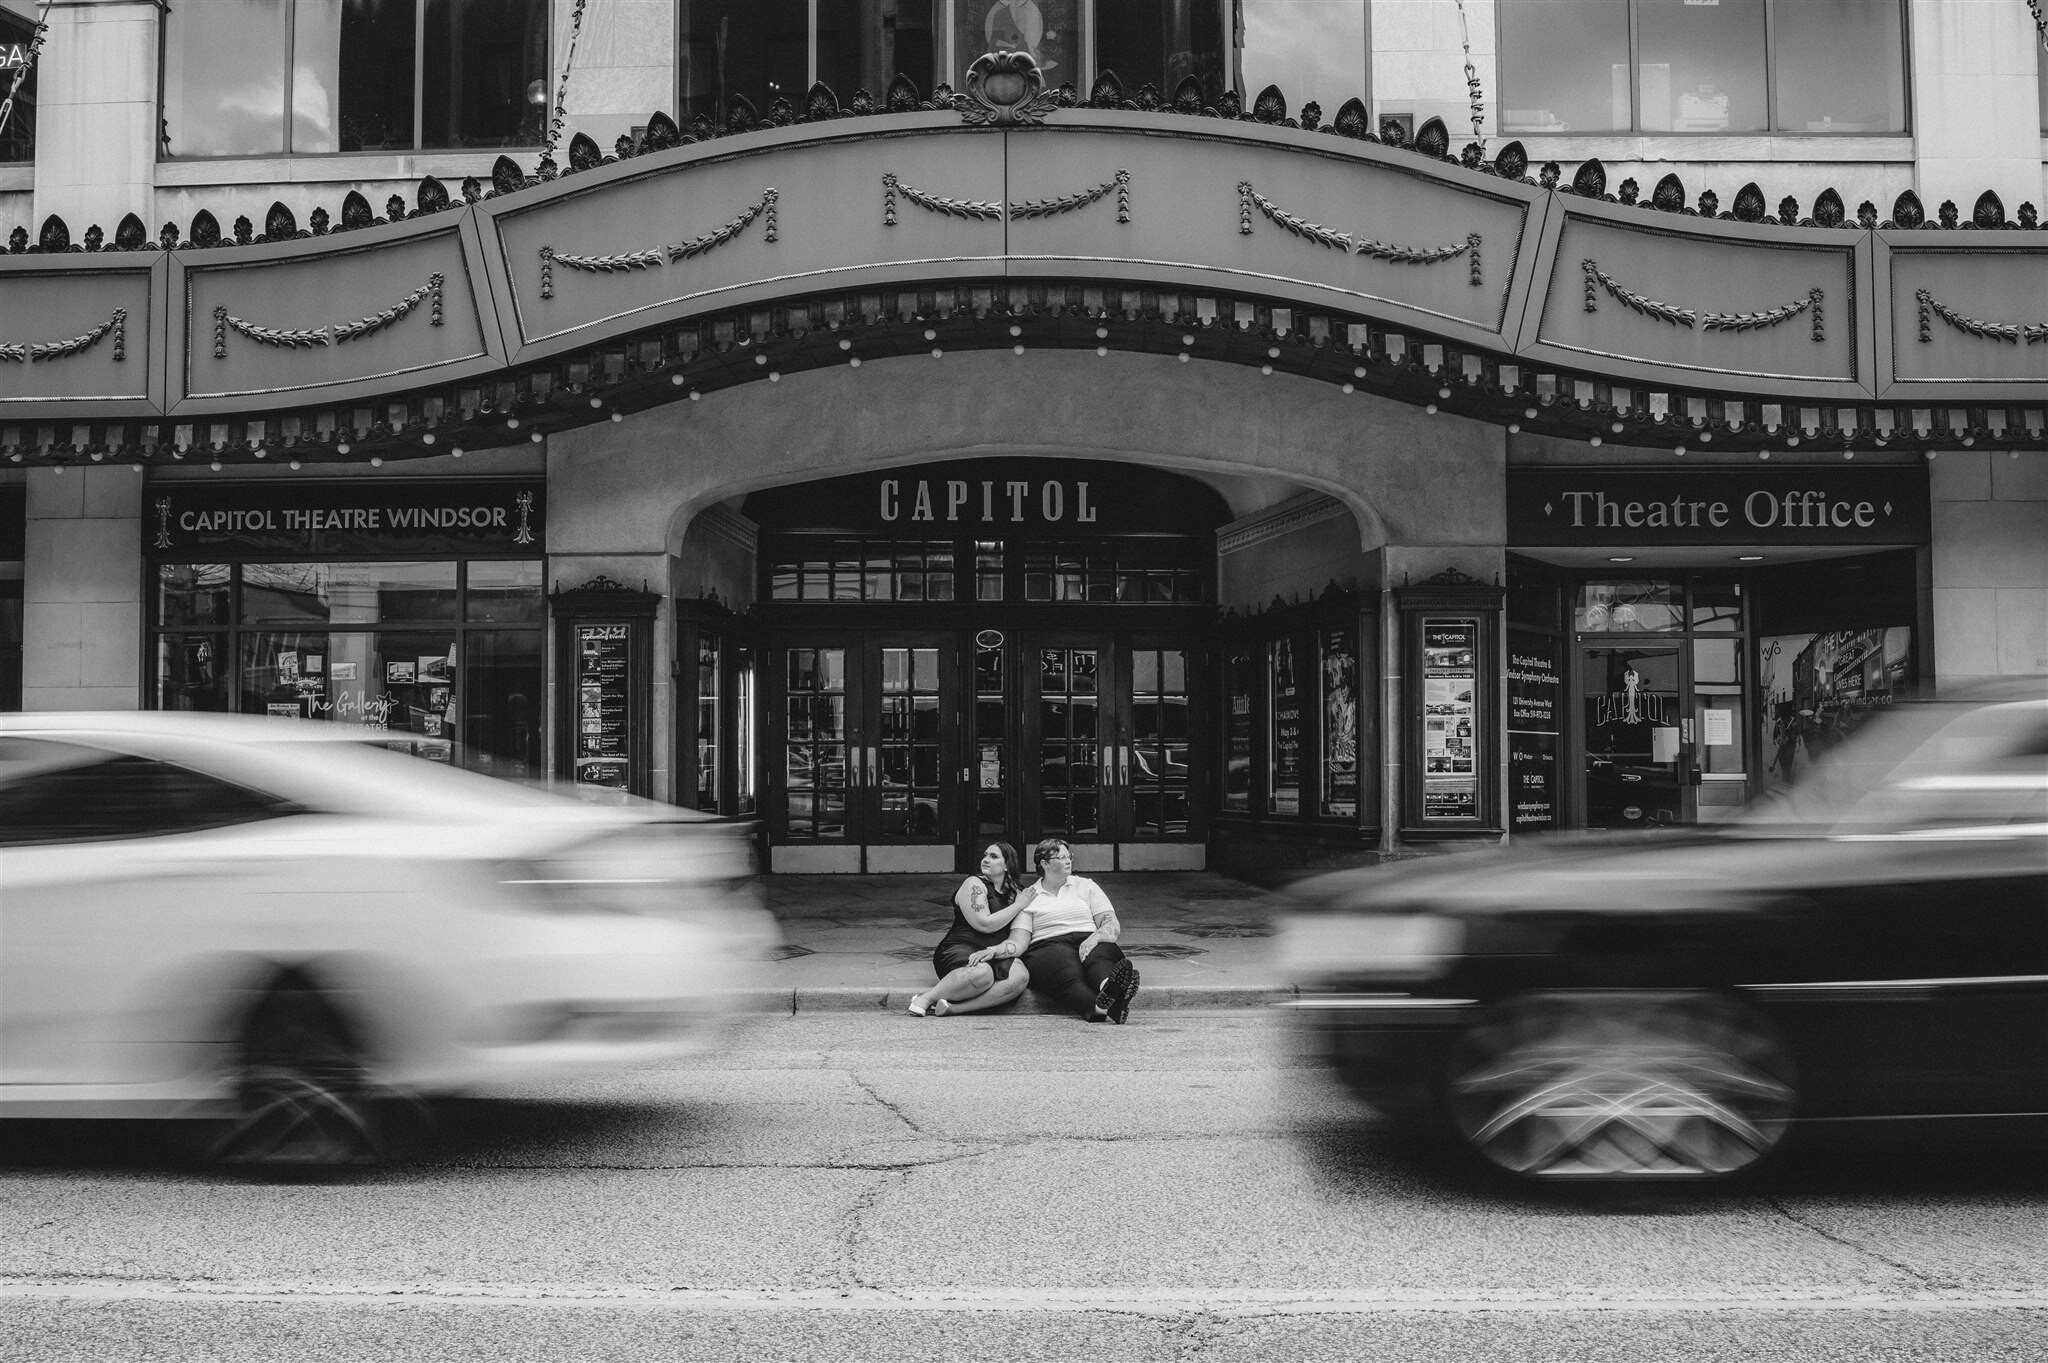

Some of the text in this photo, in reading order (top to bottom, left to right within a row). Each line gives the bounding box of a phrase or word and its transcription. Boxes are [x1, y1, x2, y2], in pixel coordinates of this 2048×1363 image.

[880, 480, 1096, 522] CAPITOL
[1562, 490, 1875, 528] Theatre Office
[179, 507, 507, 531] CAPITOL THEATRE WINDSOR
[1519, 655, 1534, 668] Capitol
[1533, 657, 1548, 669] Theatre
[1507, 668, 1559, 685] indsor Symphony Orchestra
[1848, 673, 1862, 688] HERE
[298, 690, 391, 724] The Gallery
[1280, 727, 1290, 739] May
[1530, 774, 1545, 784] CAPITOL
